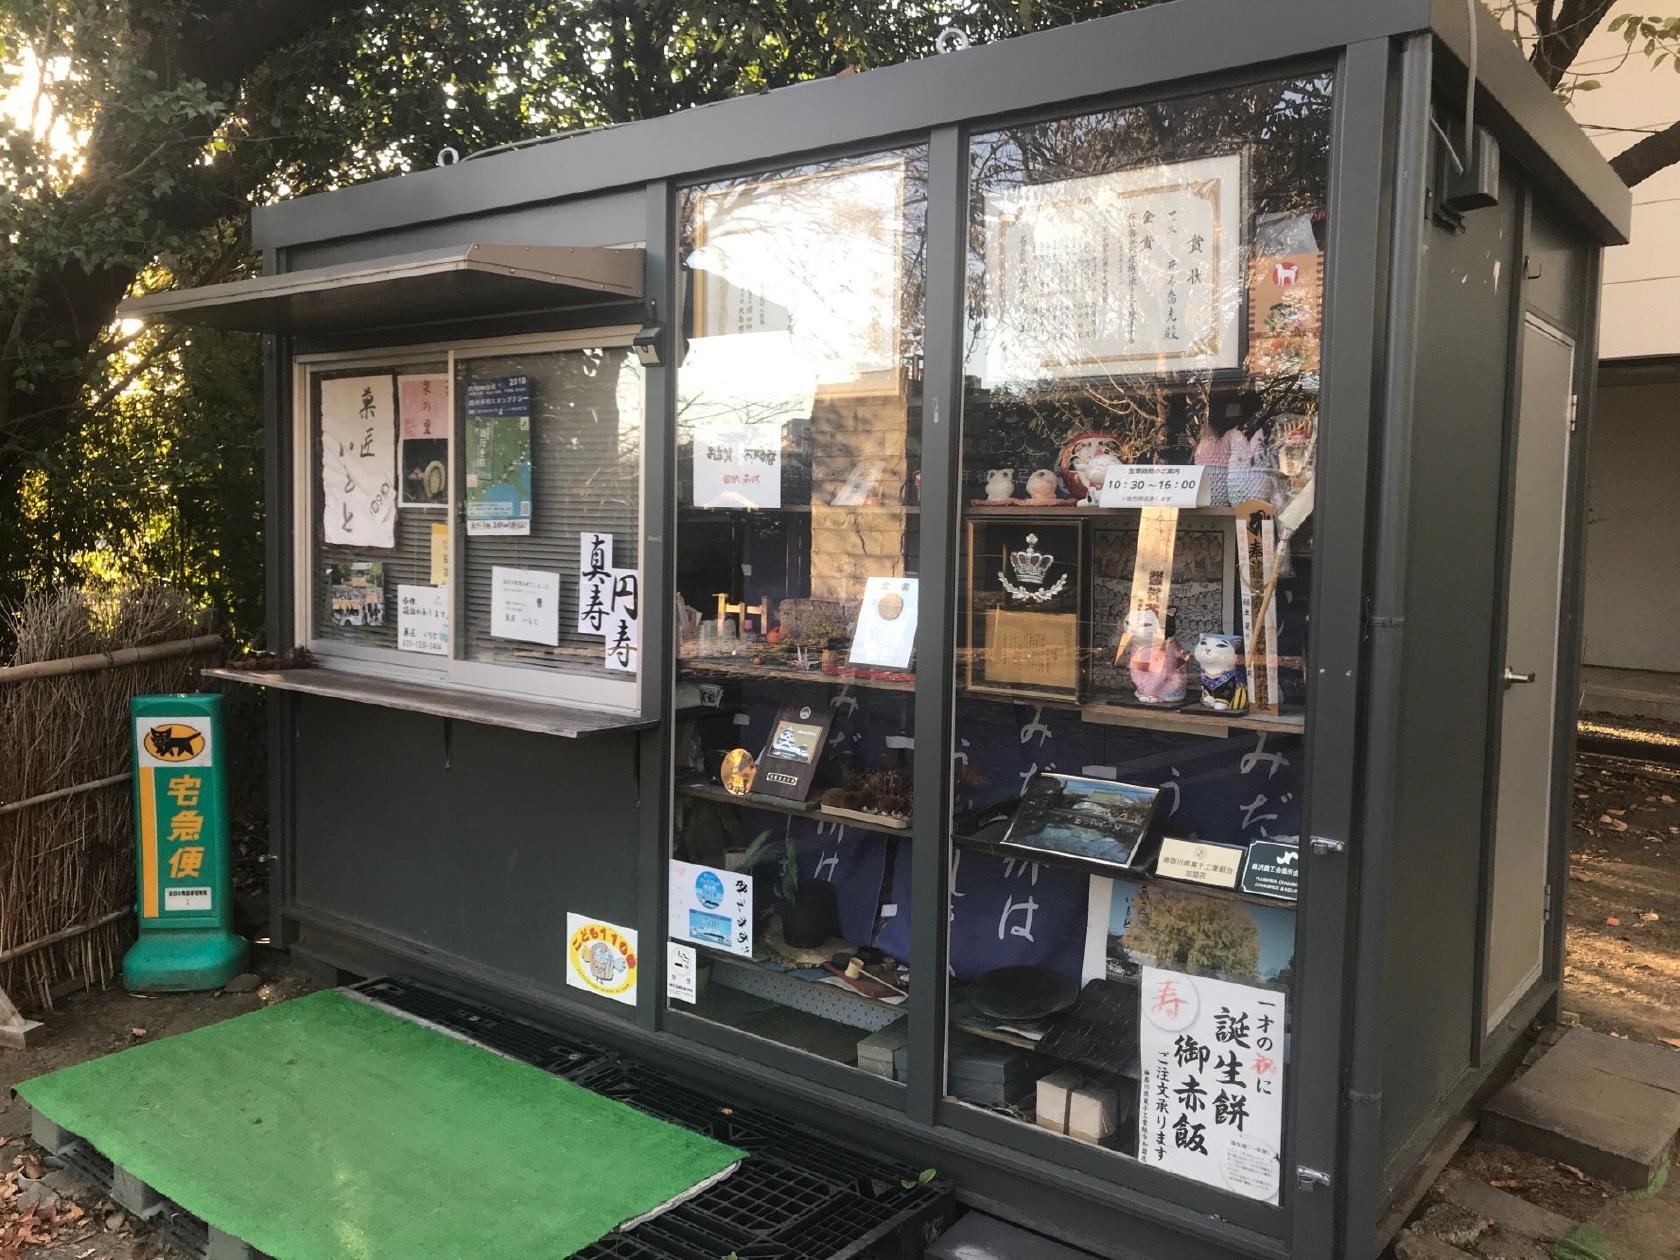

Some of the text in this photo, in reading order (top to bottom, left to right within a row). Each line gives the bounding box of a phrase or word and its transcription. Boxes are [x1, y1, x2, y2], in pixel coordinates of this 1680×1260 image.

[1186, 234, 1204, 286] 賞状
[359, 386, 377, 459] 菓匠
[581, 534, 612, 632] 真寿
[607, 574, 638, 668] 円寿
[167, 774, 205, 878] 宅急便
[1151, 979, 1187, 1020] 寿
[1155, 1051, 1171, 1162] ご注文承ります
[1172, 1033, 1211, 1157] 御赤飯
[1211, 1006, 1251, 1132] 誕生餅
